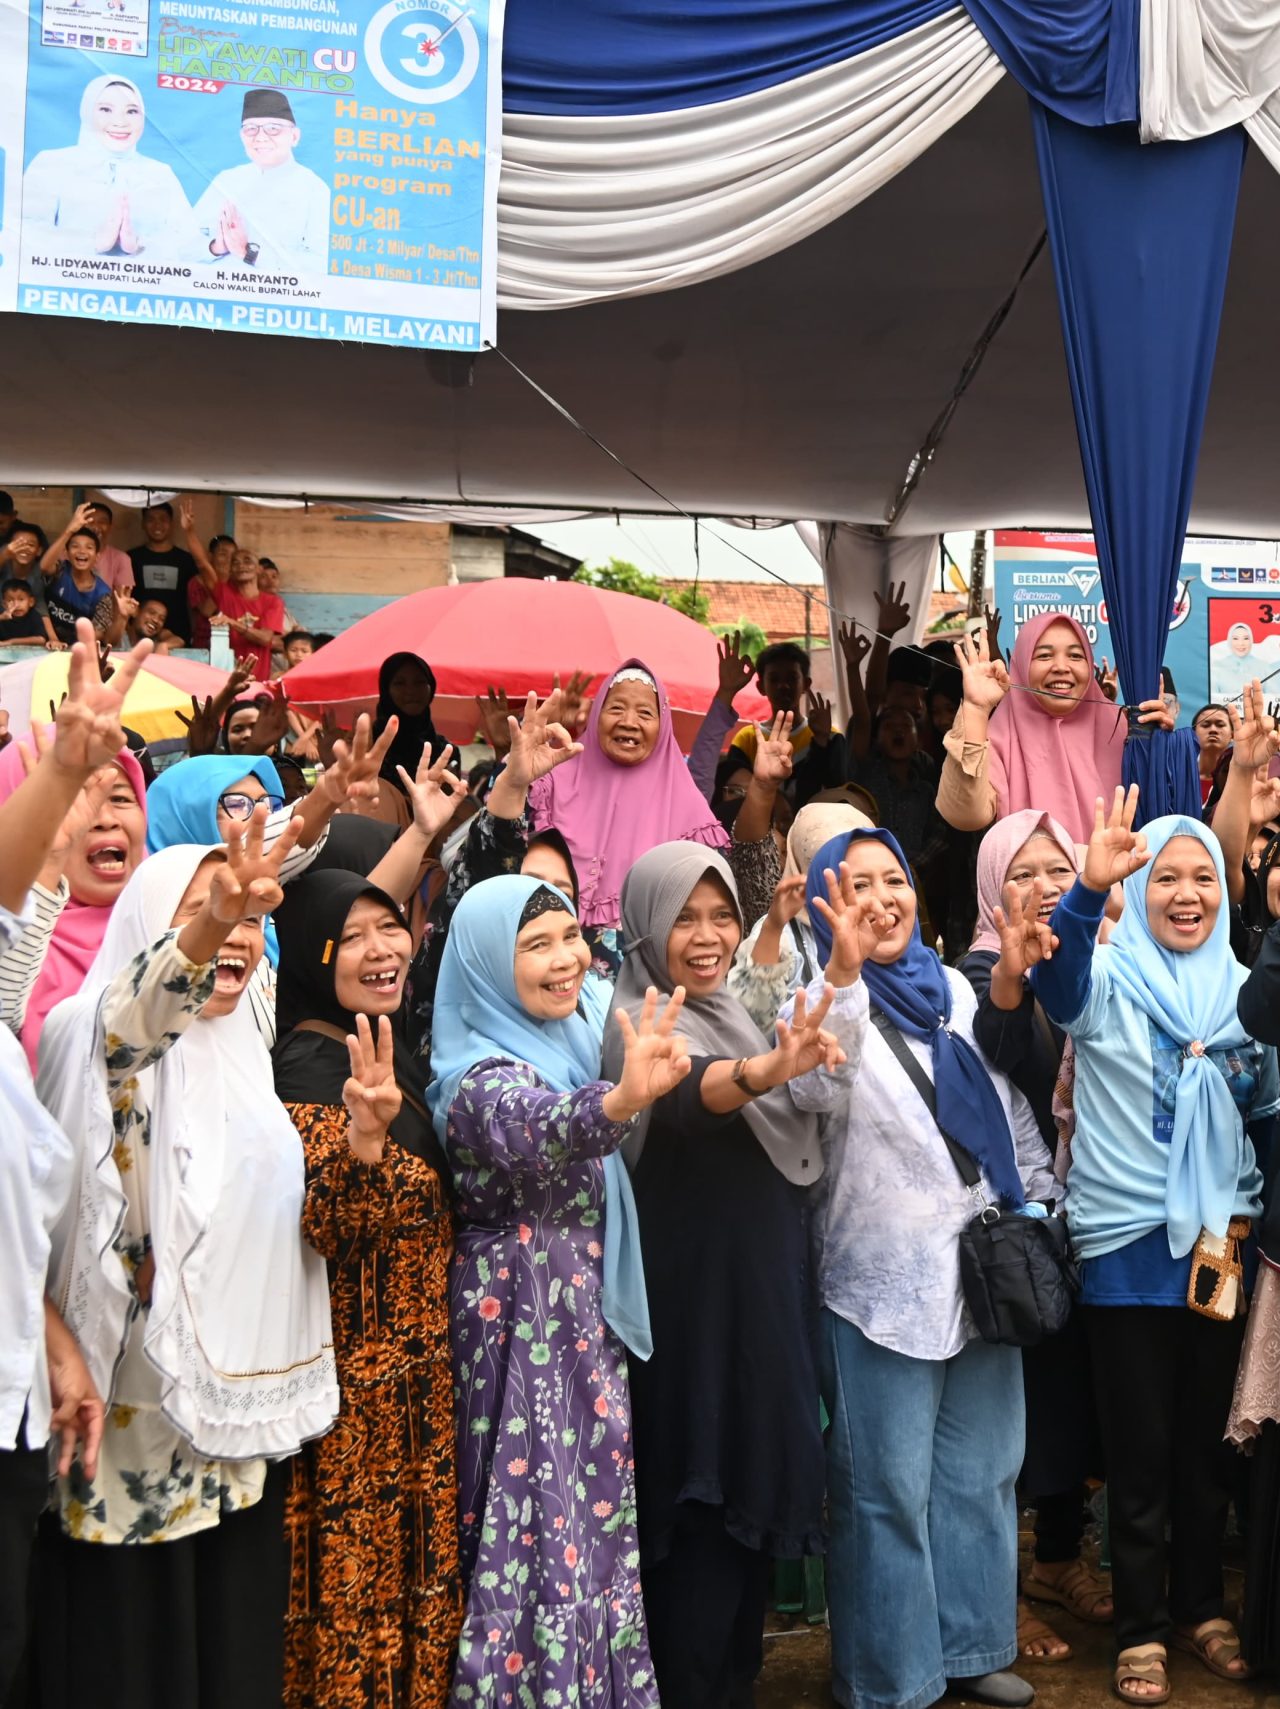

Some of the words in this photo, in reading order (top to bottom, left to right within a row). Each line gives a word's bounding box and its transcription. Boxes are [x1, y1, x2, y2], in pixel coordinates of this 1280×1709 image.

[396, 0, 450, 14] NOMOR
[160, 2, 257, 26] MENUNTASKAN
[261, 13, 358, 36] PEMBANGUNAN
[159, 35, 308, 69] LIDYAWATI
[312, 48, 357, 73] CU
[399, 22, 446, 77] 3
[158, 55, 355, 92] HARYANTO
[160, 75, 218, 93] 2024
[335, 99, 436, 128] Hanya
[334, 128, 481, 159] BERLIAN
[335, 150, 384, 167] yang
[391, 155, 453, 172] punya
[334, 173, 452, 196] program
[333, 194, 401, 231] CU-an
[331, 235, 352, 250] 500
[377, 239, 385, 254] 2
[31, 256, 51, 267] HJ.
[54, 257, 121, 272] LIDYAWATI
[124, 263, 145, 274] CIK
[148, 264, 192, 278] UJANG
[62, 270, 94, 280] CALON
[97, 272, 130, 282] BUPATI
[132, 275, 161, 285] LAHAT
[344, 260, 371, 277] Desa
[375, 263, 412, 281] Wisma
[416, 267, 422, 282] 1
[433, 269, 439, 284] 3
[193, 281, 225, 291] CALON
[228, 283, 256, 293] WAKIL
[258, 285, 290, 296] BUPATI
[293, 289, 321, 298] LAHAT
[216, 271, 228, 280] H.
[231, 272, 299, 286] HARYANTO
[24, 288, 223, 328] PENGALAMAN,
[231, 305, 336, 337] PEDULI,
[344, 314, 474, 346] MELAYANI
[1017, 574, 1066, 584] BERLIAN
[1258, 604, 1274, 624] 3
